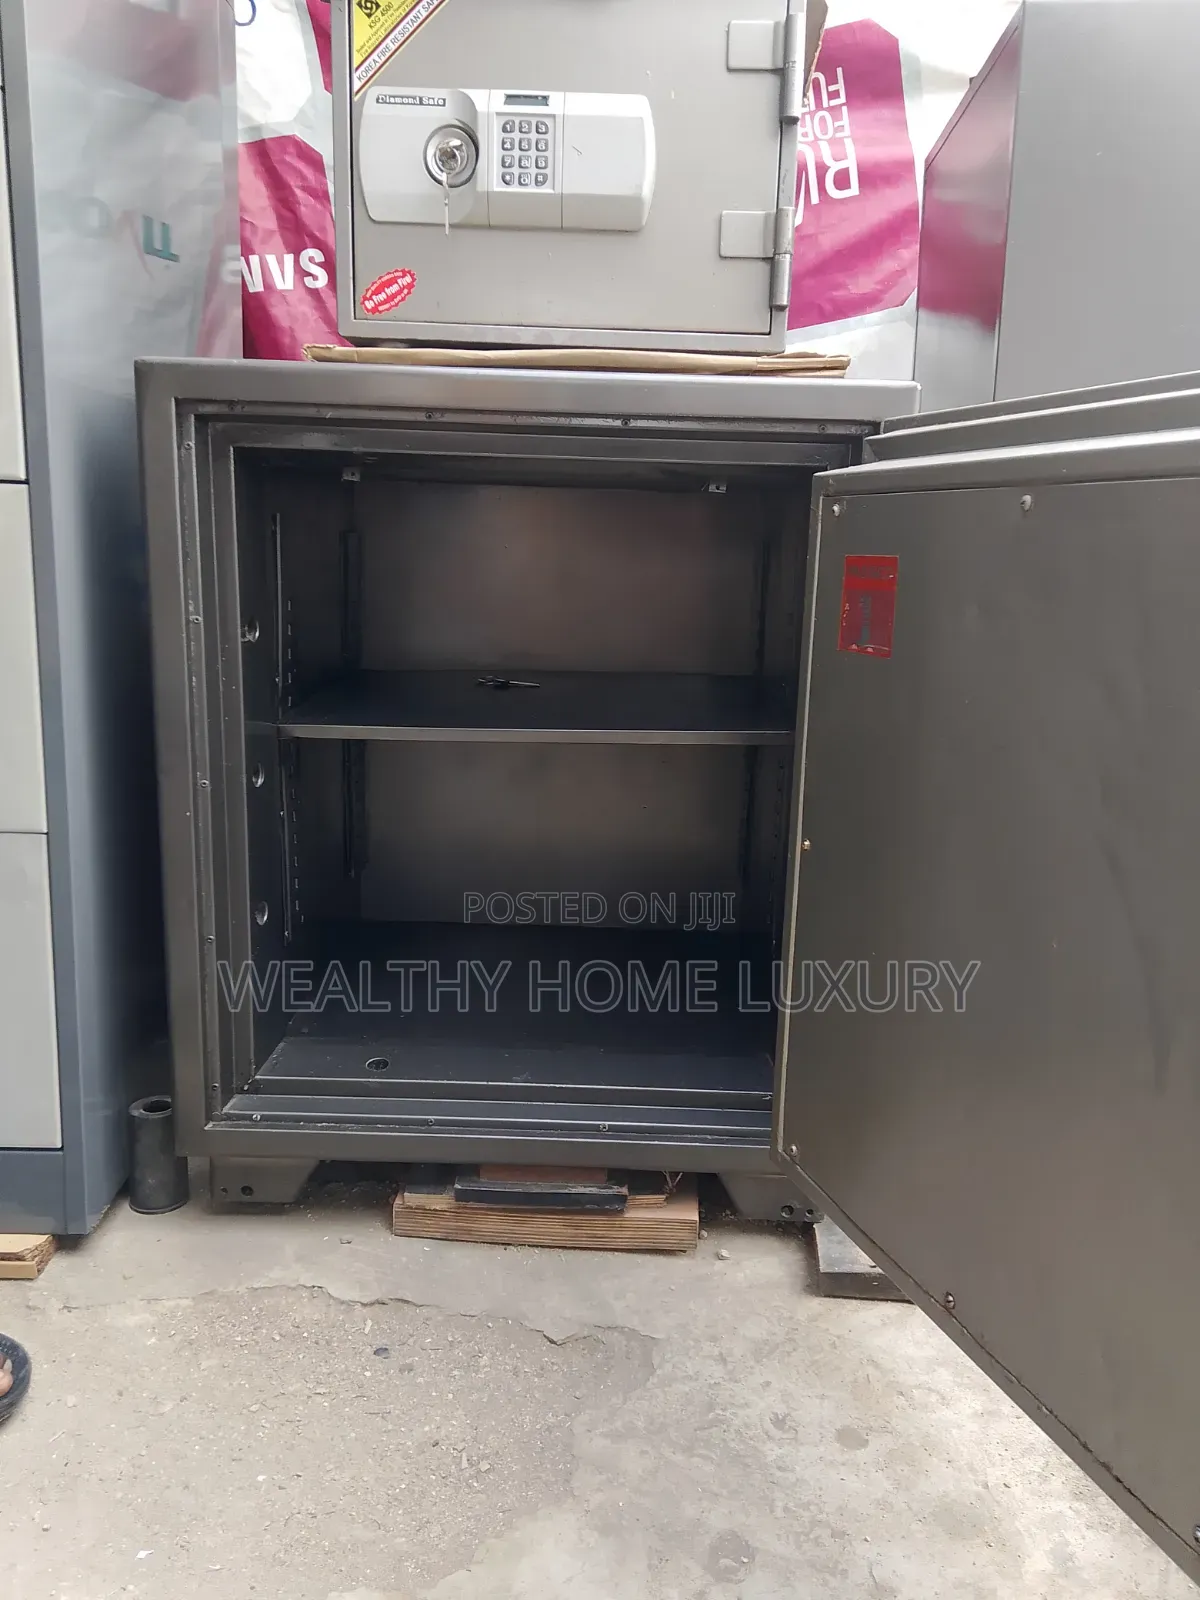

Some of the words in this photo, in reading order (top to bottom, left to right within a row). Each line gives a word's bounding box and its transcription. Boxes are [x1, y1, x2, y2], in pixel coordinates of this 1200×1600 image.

[368, 15, 382, 30] KSG
[379, 1, 394, 17] 4500
[356, 58, 380, 83] KOREA
[376, 43, 393, 60] FIRE
[390, 9, 425, 46] RESISTANT
[378, 95, 420, 105] Diamond
[422, 97, 445, 106] Safe
[372, 291, 387, 305] Free
[384, 283, 400, 297] from
